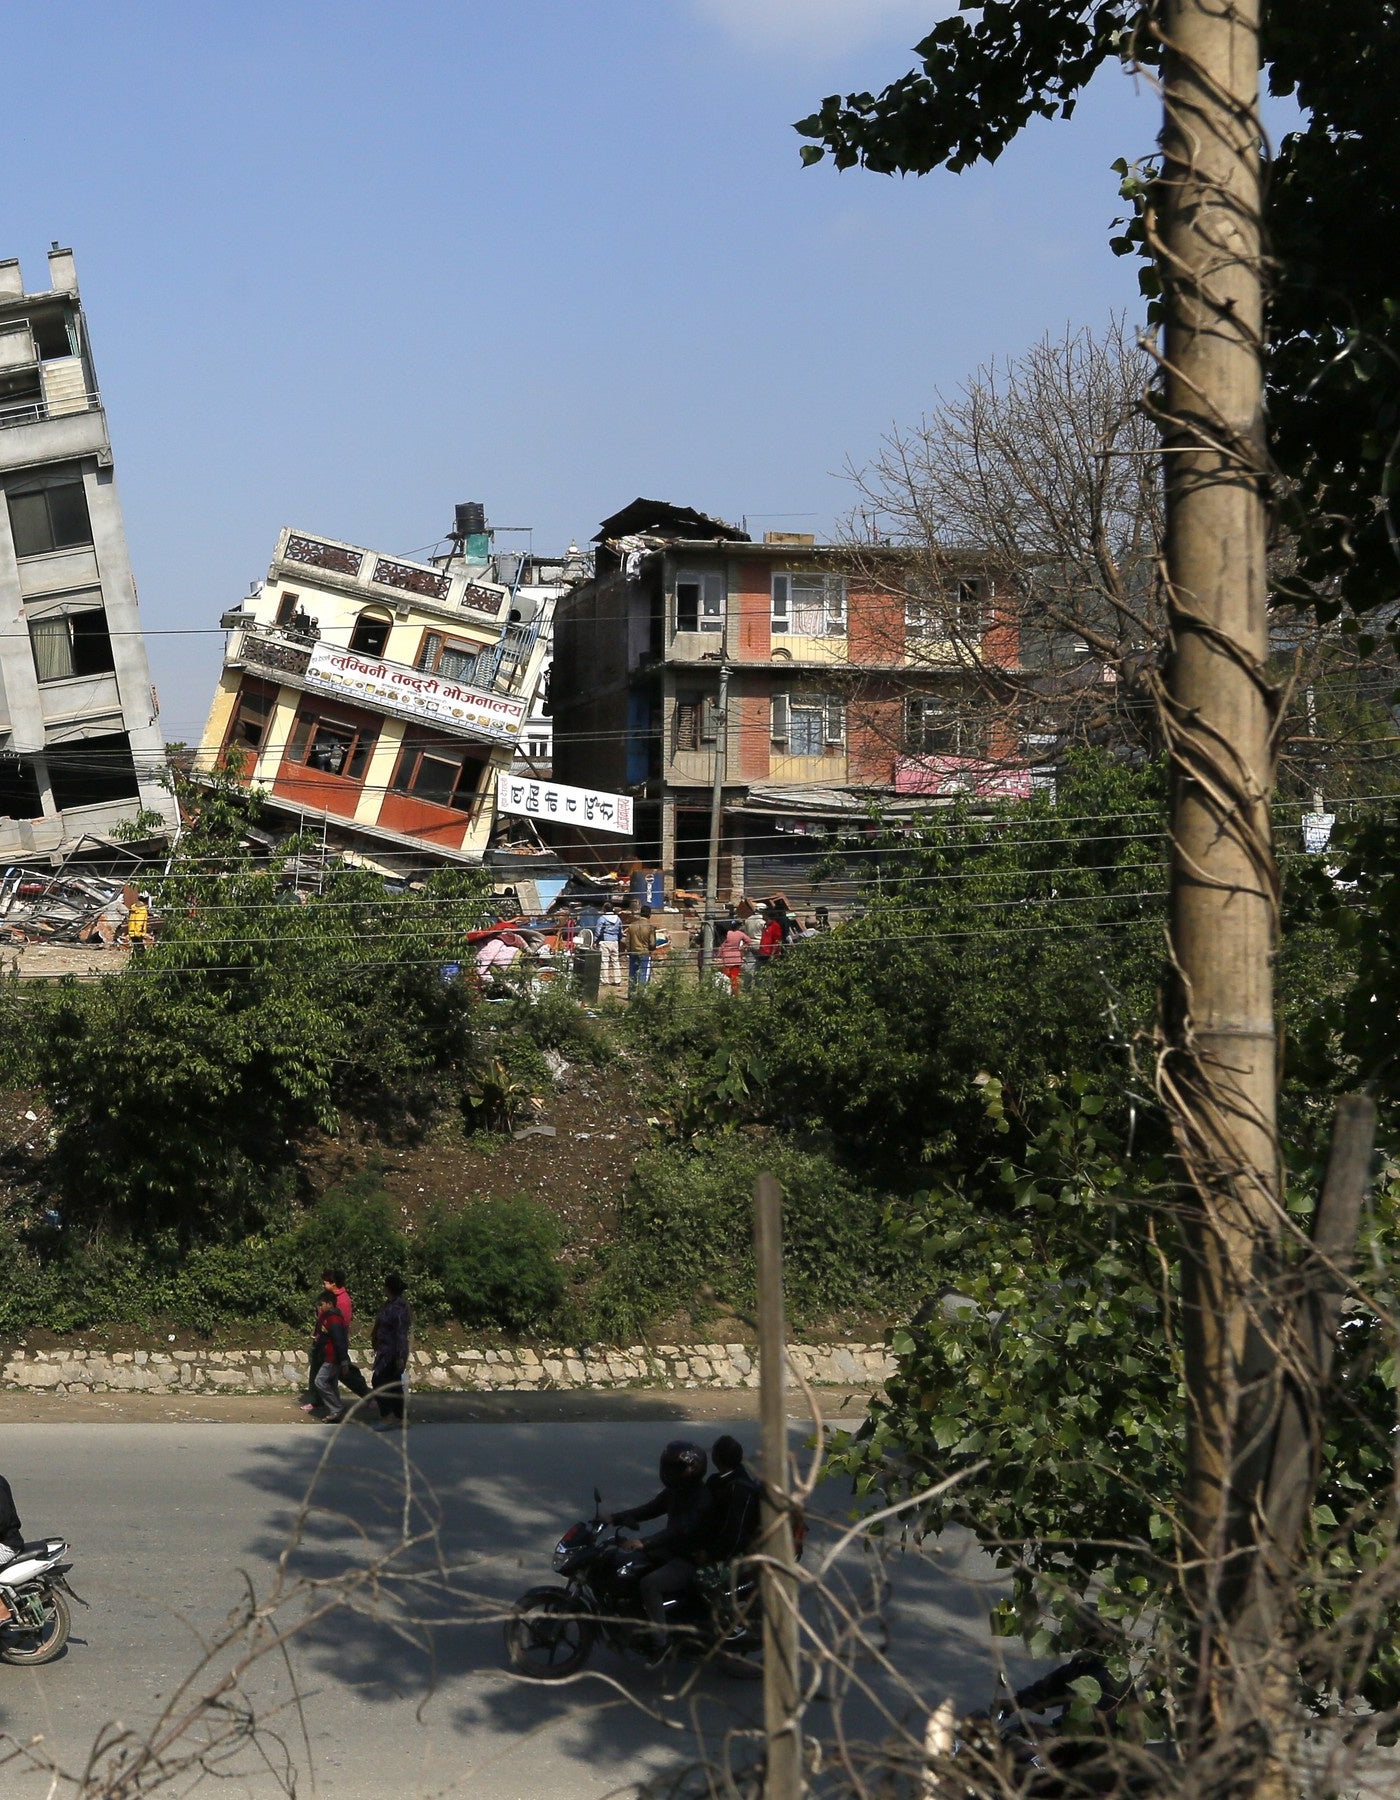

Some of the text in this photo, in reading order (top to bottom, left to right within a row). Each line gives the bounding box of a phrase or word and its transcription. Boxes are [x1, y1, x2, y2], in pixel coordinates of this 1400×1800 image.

[330, 654, 388, 680] लुम्बिनी
[391, 671, 440, 694] तन्दुरी
[443, 686, 523, 718] भोजनालय
